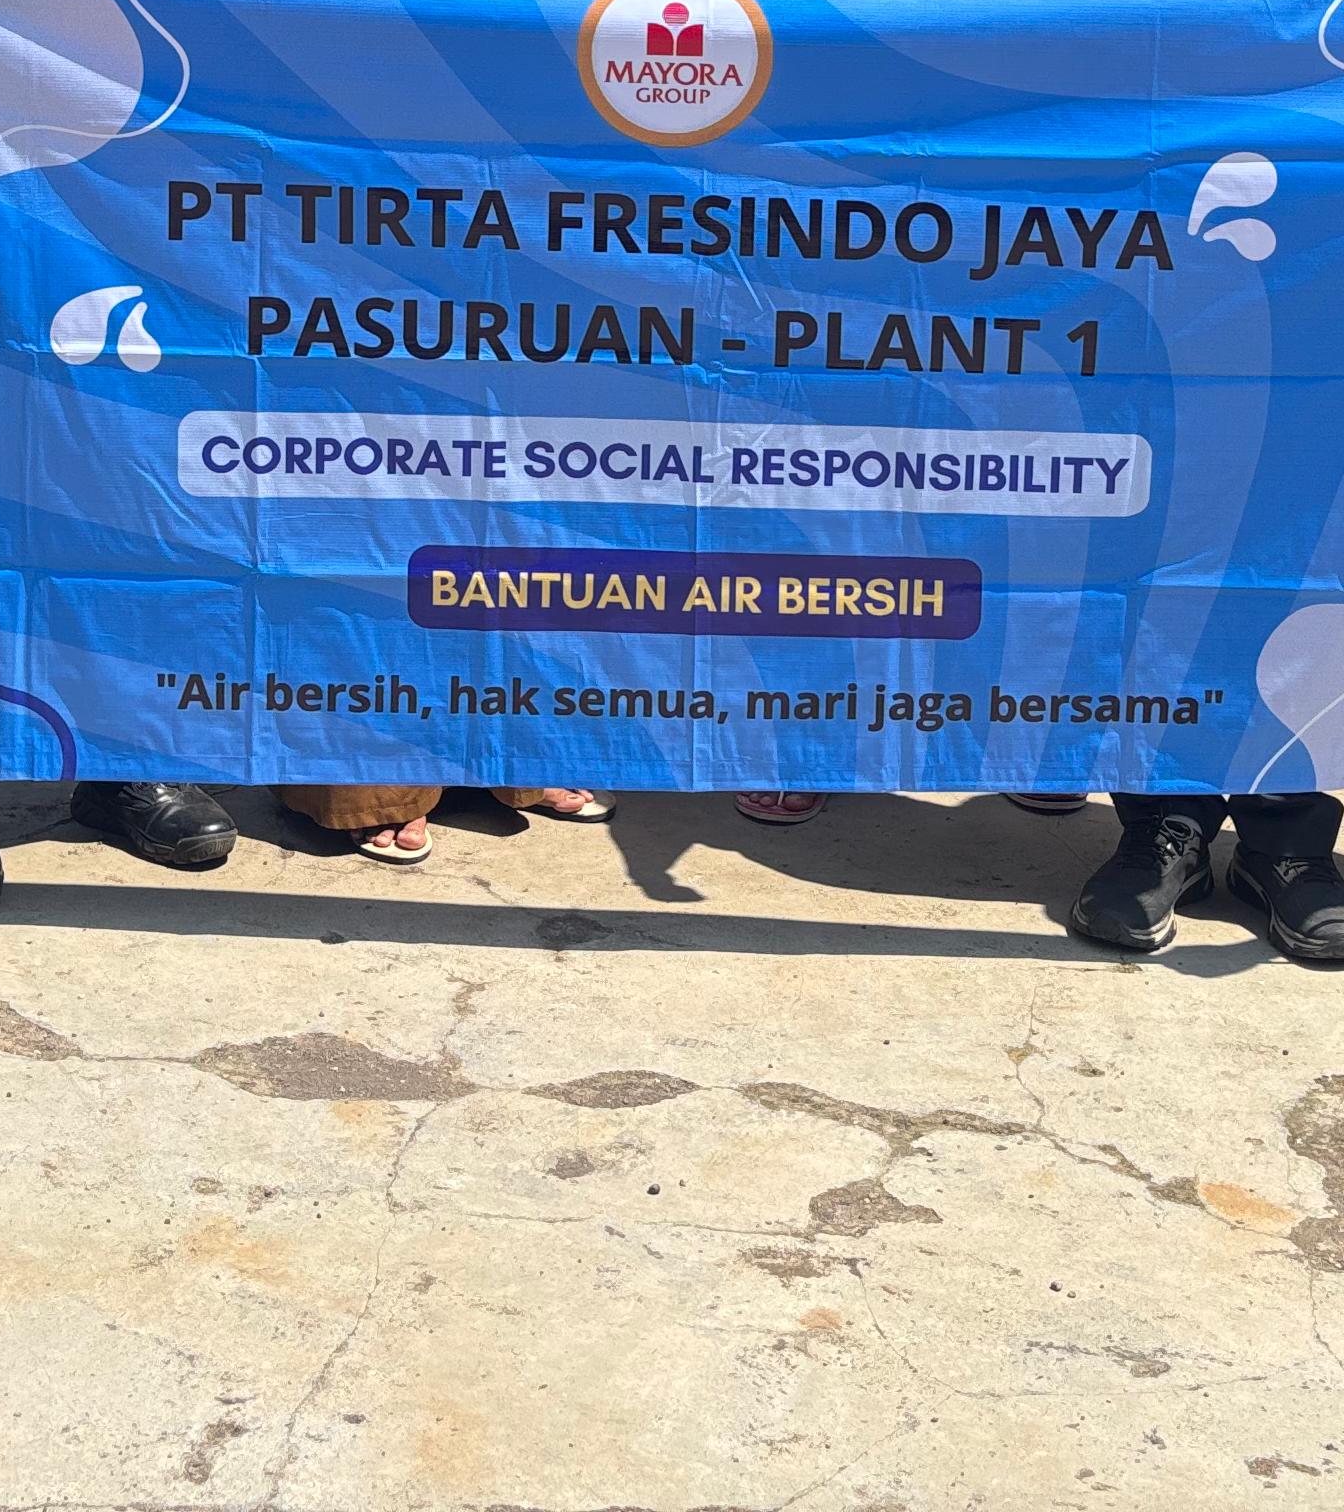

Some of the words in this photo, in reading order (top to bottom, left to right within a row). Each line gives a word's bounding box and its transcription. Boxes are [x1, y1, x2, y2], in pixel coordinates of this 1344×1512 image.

[604, 60, 744, 86] MAYORA
[636, 87, 711, 104] GROUP
[168, 180, 263, 242] PT
[285, 184, 520, 250] TIRTA
[547, 191, 953, 263] FRESINDO
[970, 205, 1174, 281] JAYA
[248, 296, 694, 366] PASURUAN
[722, 339, 746, 351] -
[774, 310, 1041, 375] PLANT
[1067, 320, 1099, 377] 1
[201, 435, 507, 478] CORPORATE
[523, 440, 715, 484] SOCIAL
[731, 444, 1131, 495] RESPONSIBILITY
[431, 570, 666, 611] BANTUAN
[682, 576, 762, 614] AIR
[777, 577, 944, 617] BERSIH
[156, 673, 251, 712] "Air
[265, 673, 432, 720] bersih,
[450, 675, 540, 716] hak
[553, 687, 729, 725] semua,
[746, 682, 858, 720] mari
[867, 684, 973, 732] jaga
[989, 685, 1224, 725] bersama"
